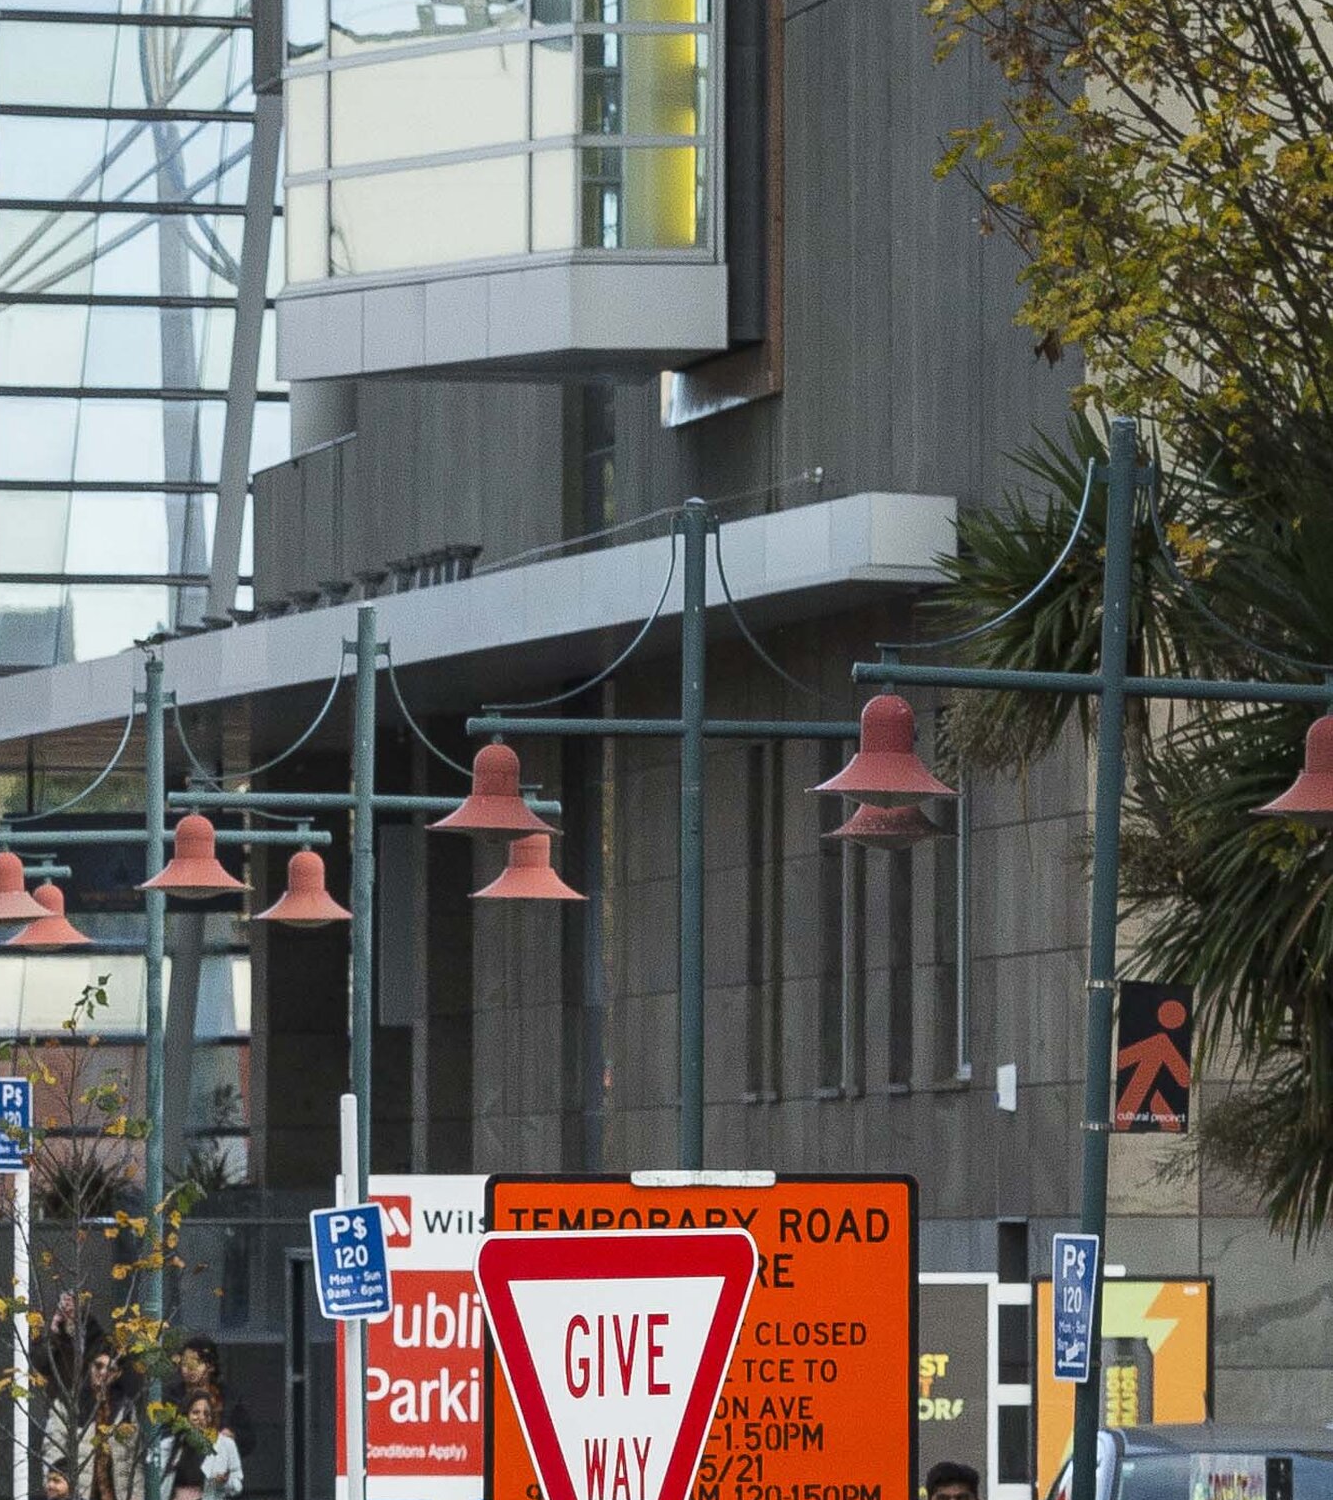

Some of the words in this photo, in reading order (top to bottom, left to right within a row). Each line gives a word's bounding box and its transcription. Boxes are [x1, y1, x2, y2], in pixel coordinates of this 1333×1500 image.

[328, 1214, 368, 1245] P$
[423, 1209, 485, 1235] Wils
[778, 1207, 891, 1244] ROAD
[334, 1245, 369, 1270] 120
[1062, 1244, 1087, 1280] P$
[328, 1275, 354, 1287] Mon
[363, 1271, 382, 1283] Sun
[1062, 1286, 1082, 1314] 120
[367, 1291, 481, 1350] ubli
[755, 1321, 868, 1347] CLOSED
[564, 1312, 672, 1399] GIVE
[742, 1359, 804, 1382] TCE
[807, 1359, 839, 1382] TO
[365, 1366, 481, 1424] Parki
[759, 1396, 814, 1420] AVE
